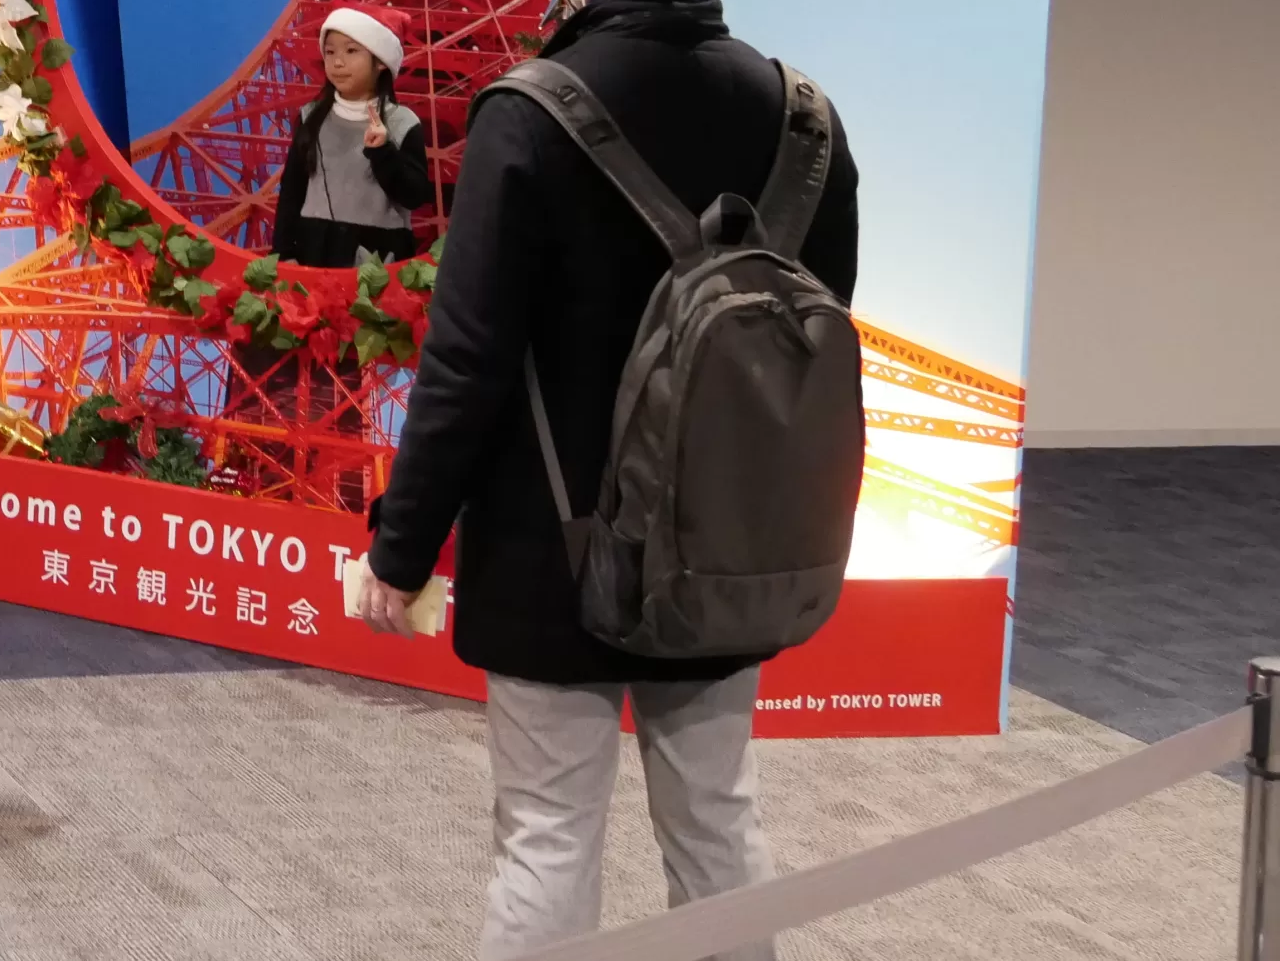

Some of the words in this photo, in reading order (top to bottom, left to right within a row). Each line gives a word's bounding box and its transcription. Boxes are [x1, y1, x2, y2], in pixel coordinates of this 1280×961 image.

[101, 505, 142, 542] to
[162, 512, 307, 574] TOKYO
[40, 548, 320, 636] 東京観光記念
[754, 694, 802, 710] ensed
[806, 694, 826, 712] by
[830, 694, 883, 709] TOKYO
[887, 692, 942, 708] TOWER
